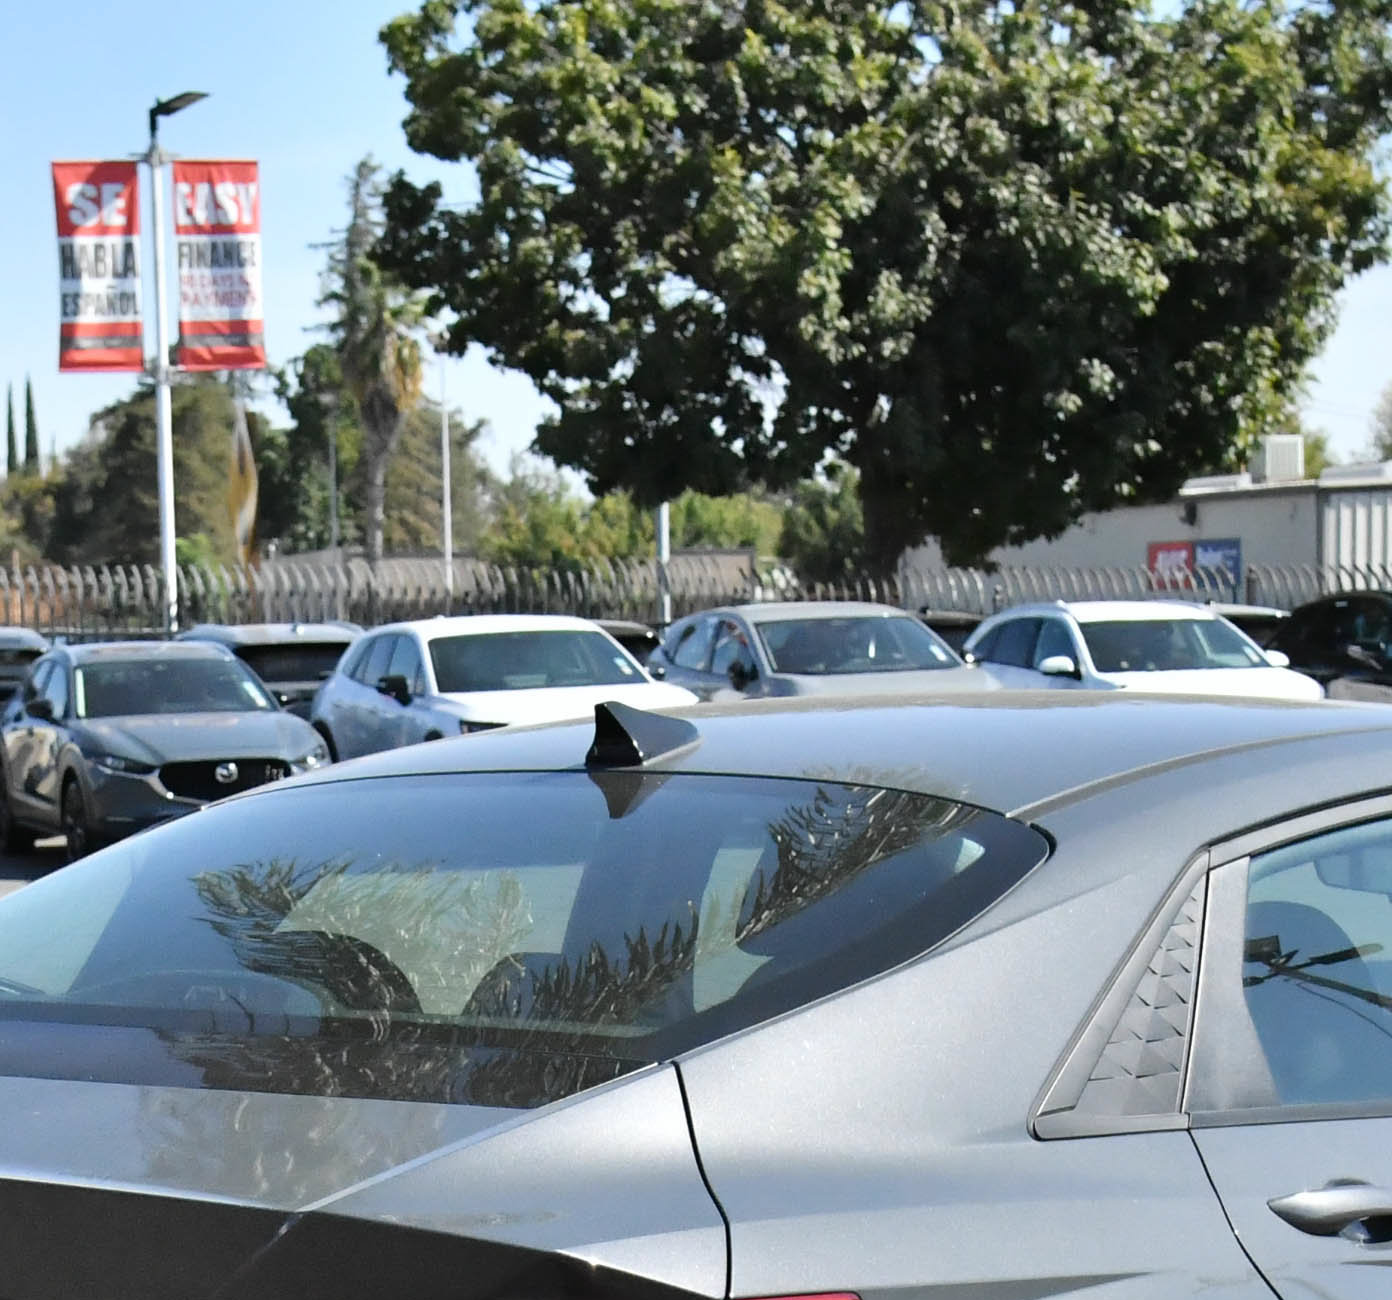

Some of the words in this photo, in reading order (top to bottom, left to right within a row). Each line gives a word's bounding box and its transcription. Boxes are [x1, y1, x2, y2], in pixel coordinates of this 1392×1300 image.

[67, 181, 128, 228] SE
[175, 181, 258, 226] EASY
[60, 241, 138, 280] HABLA
[178, 240, 256, 269] FINANCE
[61, 283, 139, 317] ESPAÑOL
